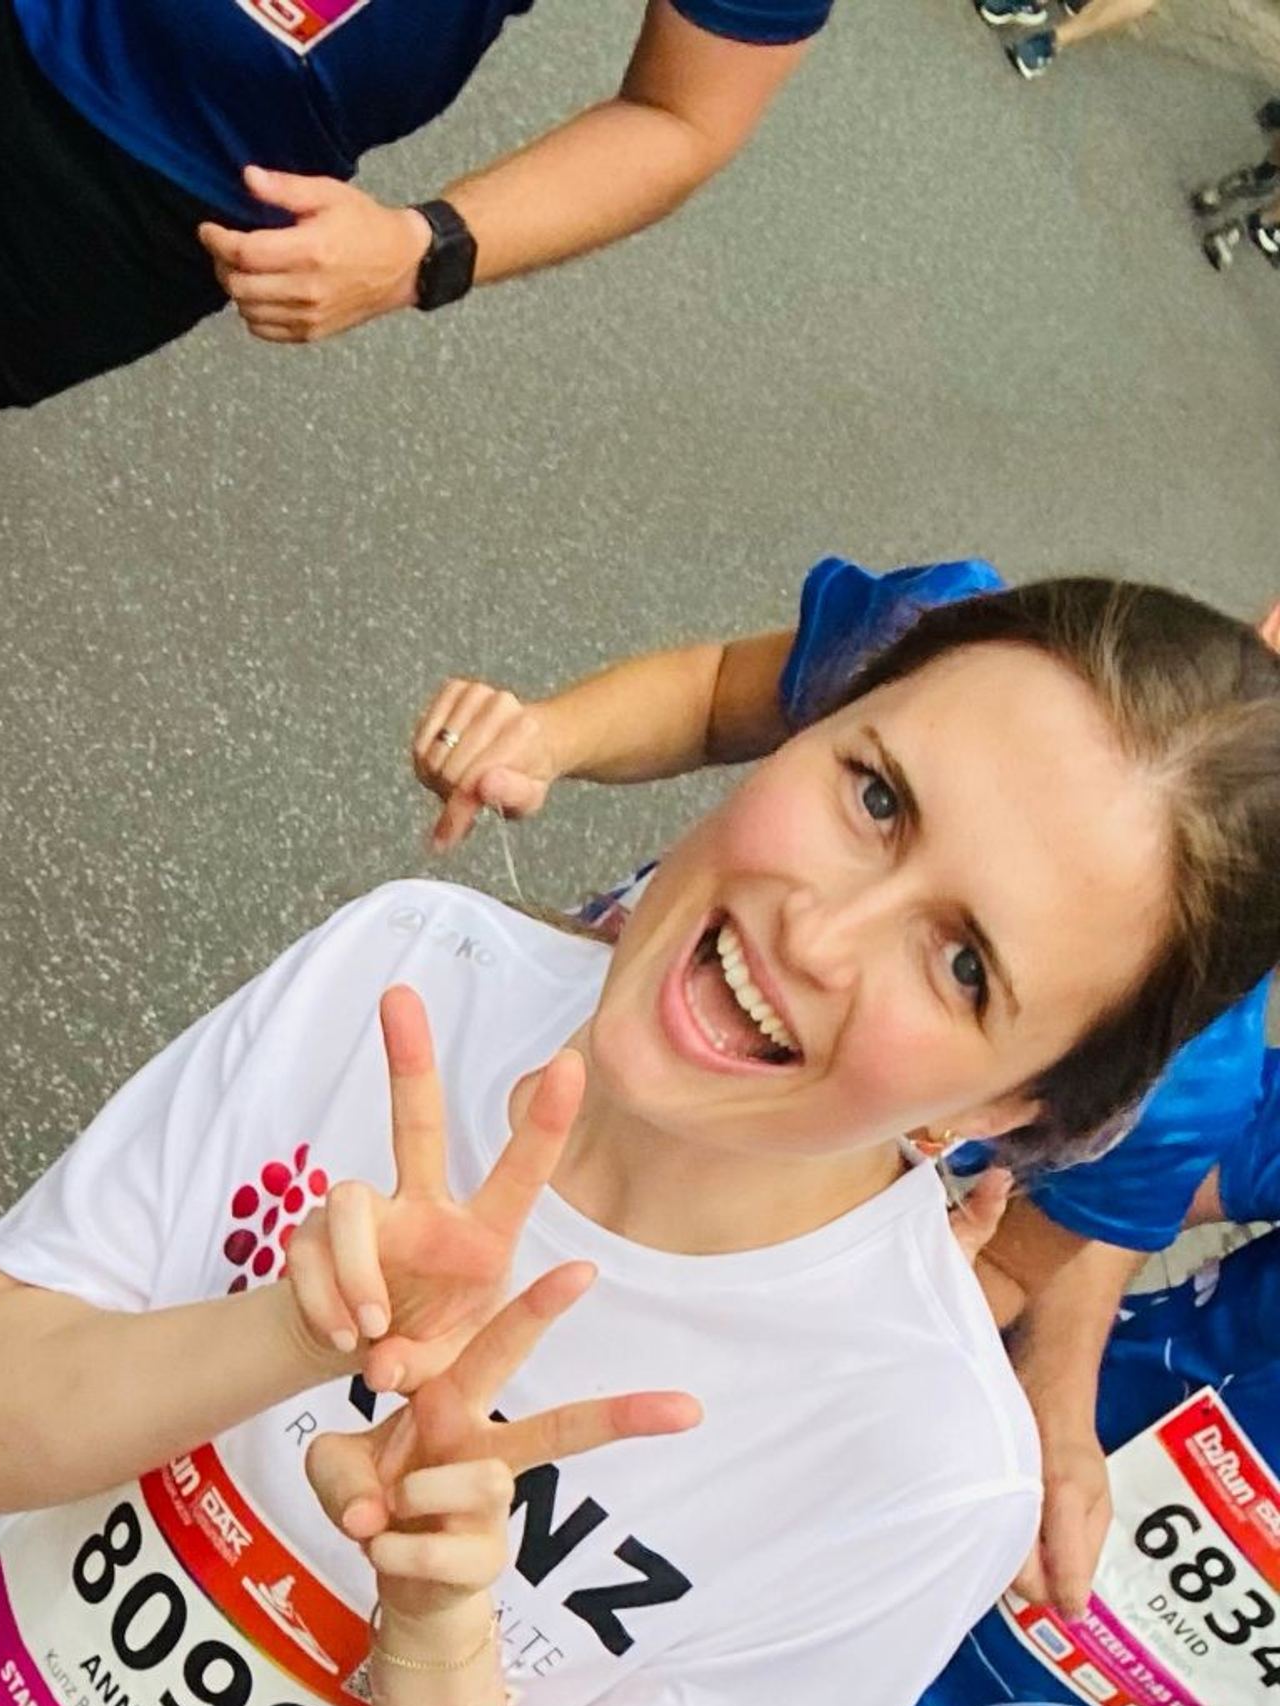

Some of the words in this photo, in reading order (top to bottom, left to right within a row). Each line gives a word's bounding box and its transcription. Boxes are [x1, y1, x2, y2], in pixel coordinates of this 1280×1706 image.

[1135, 1504, 1280, 1688] 6834
[1147, 1594, 1209, 1657] DAVID
[46, 1648, 78, 1699] Kunz
